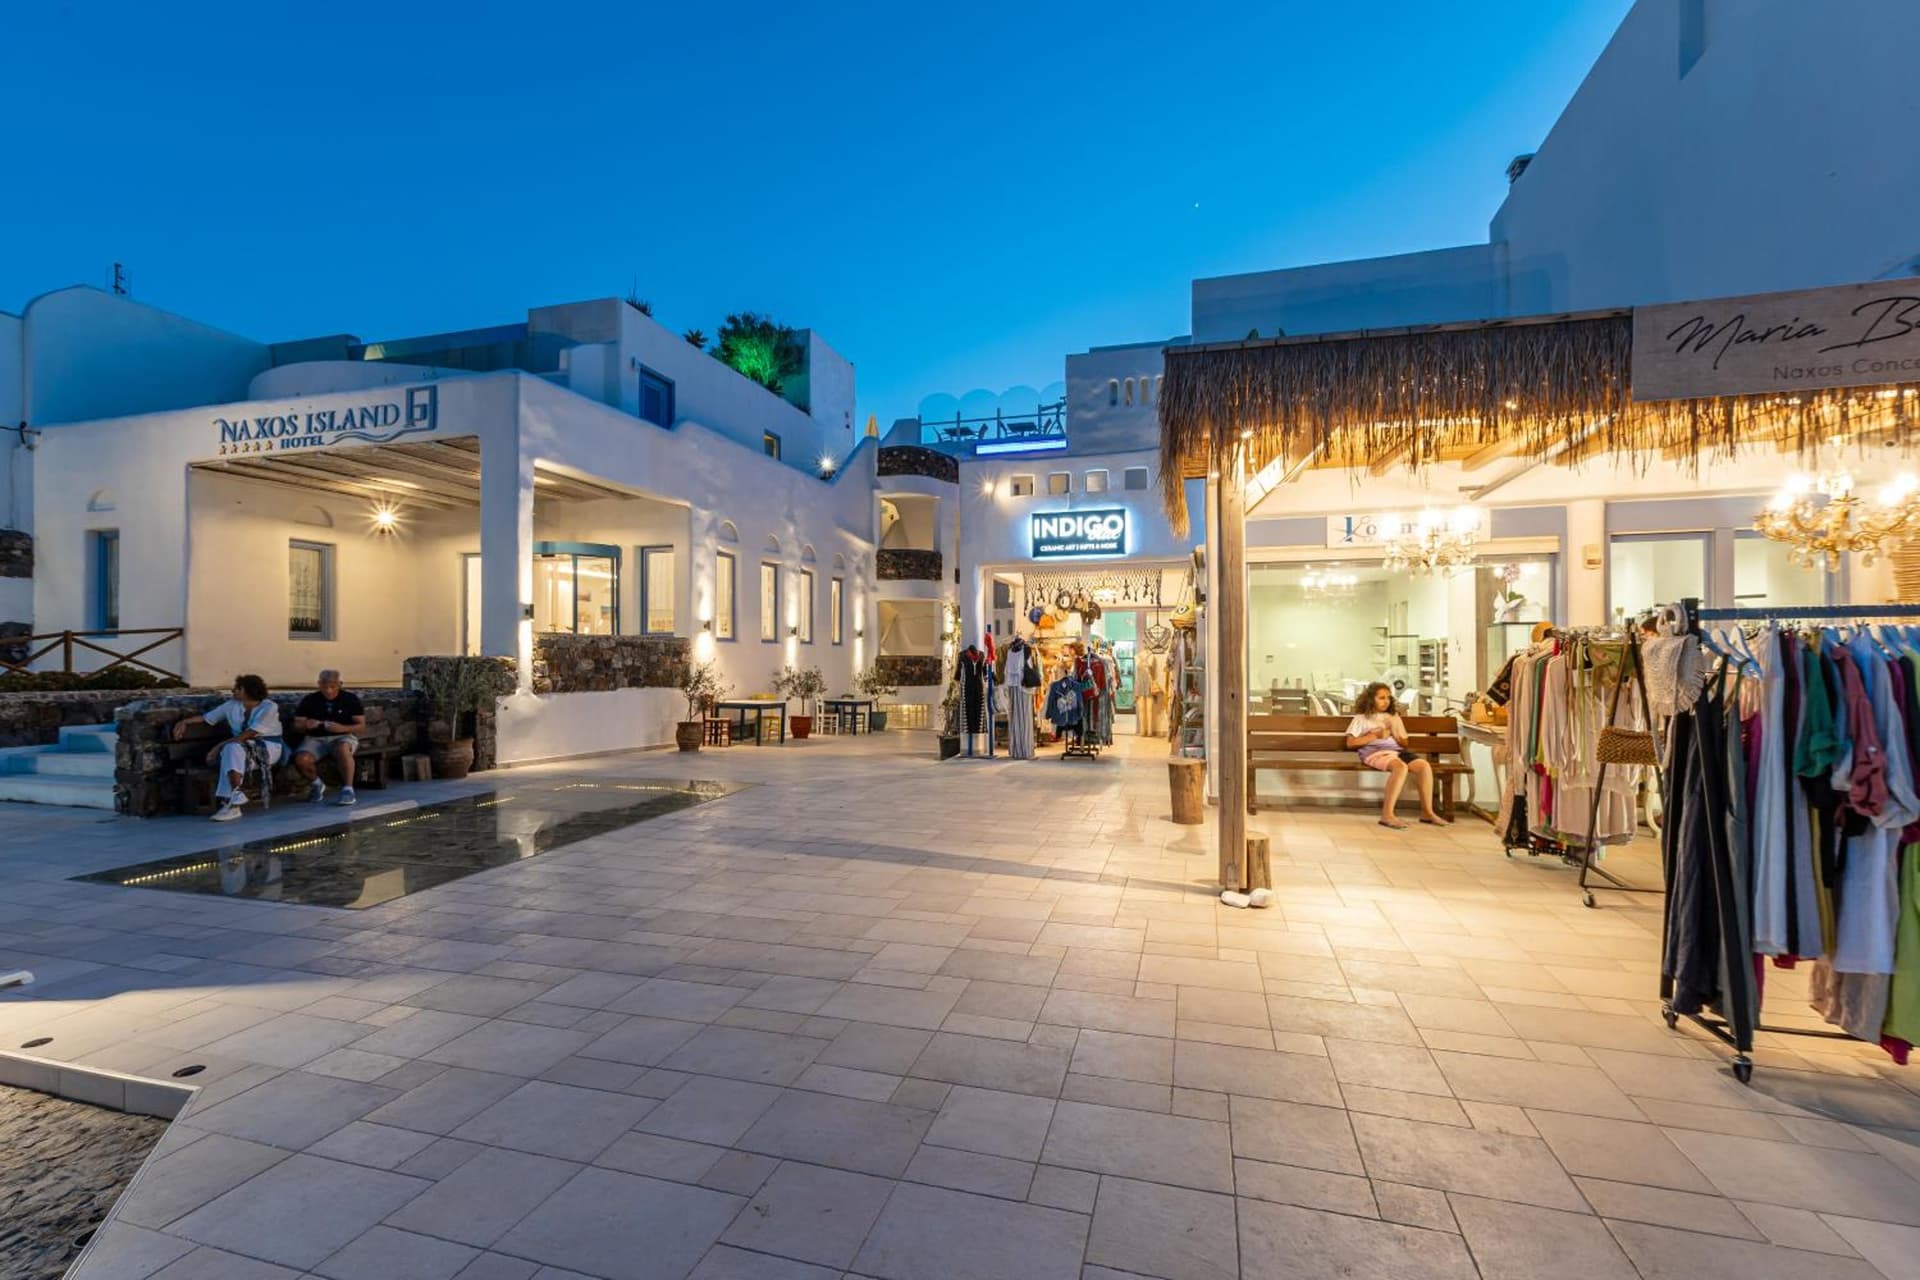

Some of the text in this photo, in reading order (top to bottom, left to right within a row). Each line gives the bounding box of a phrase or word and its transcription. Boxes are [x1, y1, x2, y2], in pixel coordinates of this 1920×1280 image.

[1666, 296, 1920, 370] Maria B
[1773, 361, 1842, 380] Naxos
[213, 403, 400, 443] NAXOS ISLAND
[280, 435, 325, 449] HOTEL
[1034, 514, 1124, 539] INDIGO
[1040, 544, 1065, 552] CERAMIC
